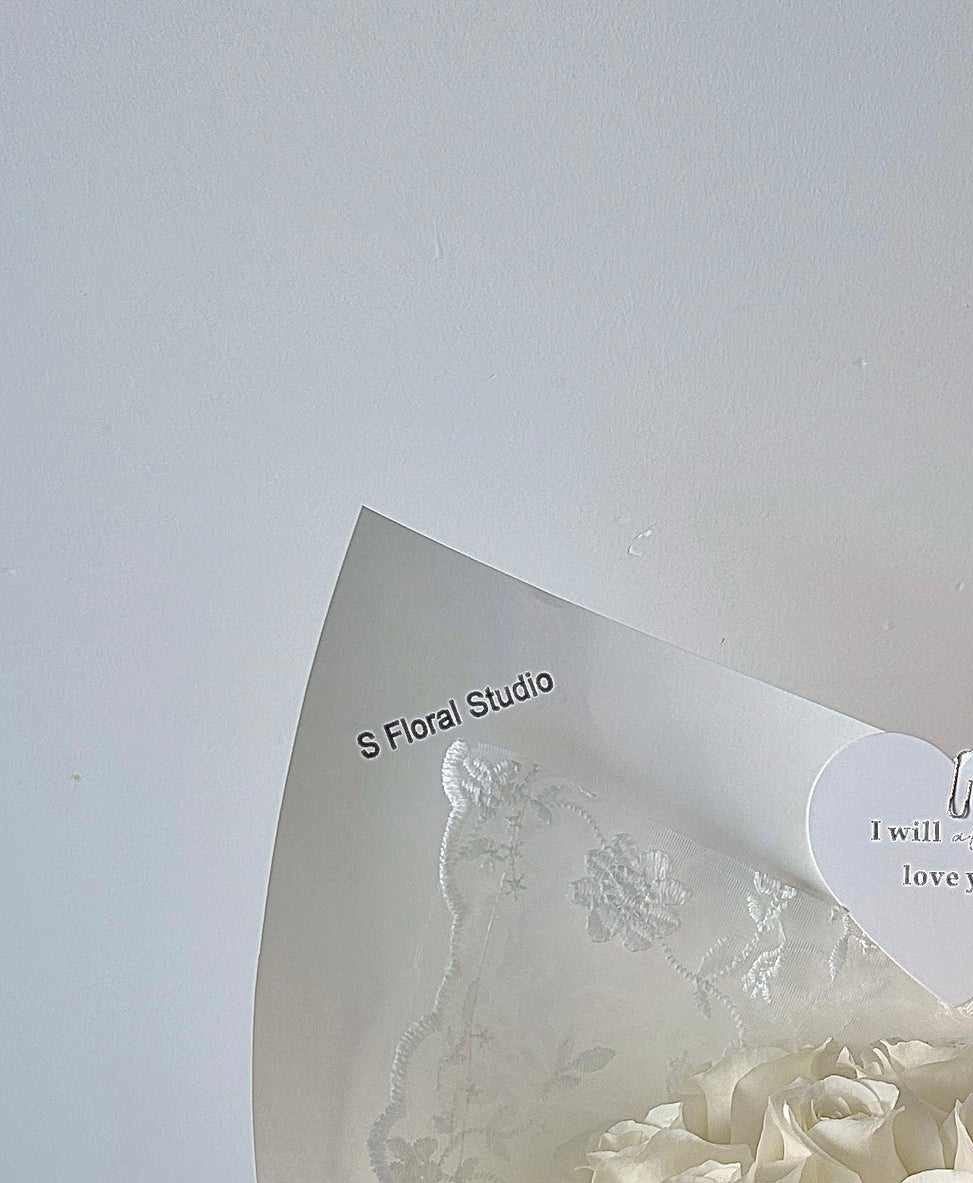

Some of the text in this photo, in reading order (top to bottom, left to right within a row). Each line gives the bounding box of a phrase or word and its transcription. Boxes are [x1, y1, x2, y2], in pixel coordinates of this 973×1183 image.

[357, 671, 554, 759] S Floral Studio
[871, 820, 881, 841] I
[888, 820, 942, 842] will
[902, 865, 959, 886] love
